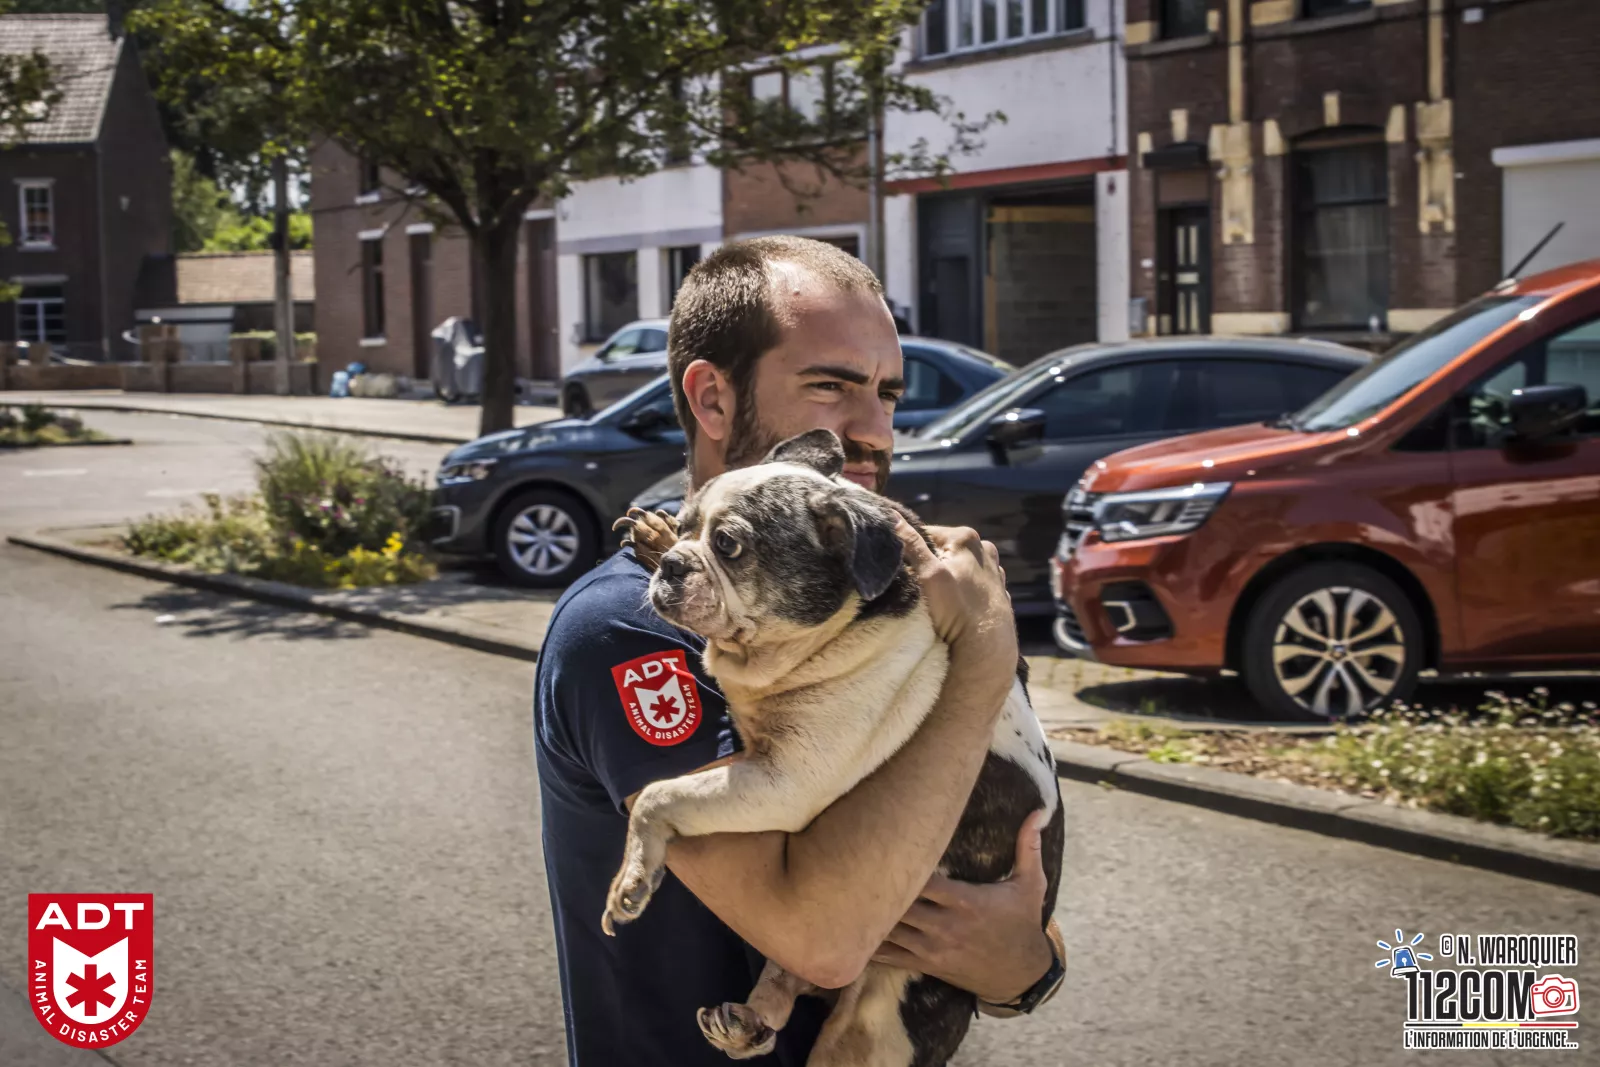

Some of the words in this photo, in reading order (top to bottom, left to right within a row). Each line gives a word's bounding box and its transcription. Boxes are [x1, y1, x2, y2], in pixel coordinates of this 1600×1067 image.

[623, 657, 679, 688] ADT
[629, 702, 652, 736] ANIMAL
[655, 712, 697, 740] DISASTER
[682, 684, 697, 710] TEAM
